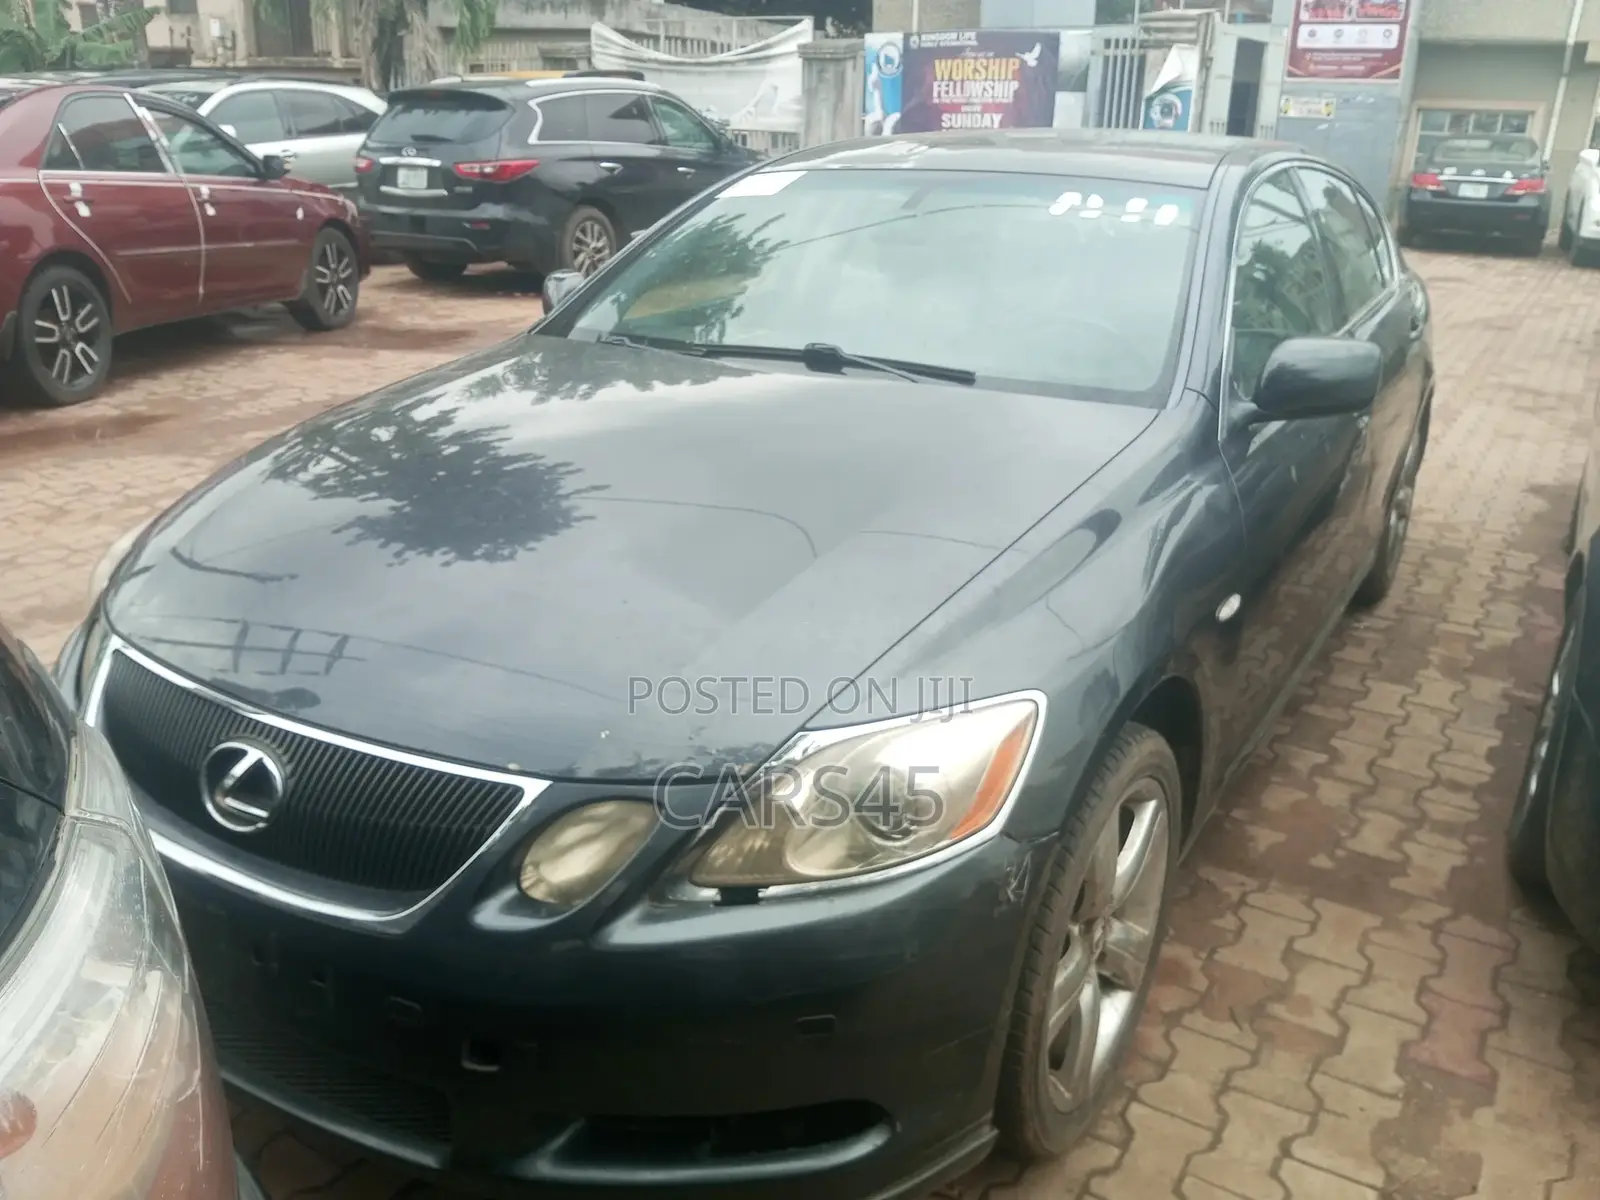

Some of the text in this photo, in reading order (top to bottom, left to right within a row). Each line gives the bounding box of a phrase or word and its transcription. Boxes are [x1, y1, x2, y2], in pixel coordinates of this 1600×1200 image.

[935, 58, 1020, 80] WORSHIP
[933, 80, 1019, 99] FELLOWSHIP
[941, 112, 1003, 129] SUNDAY
